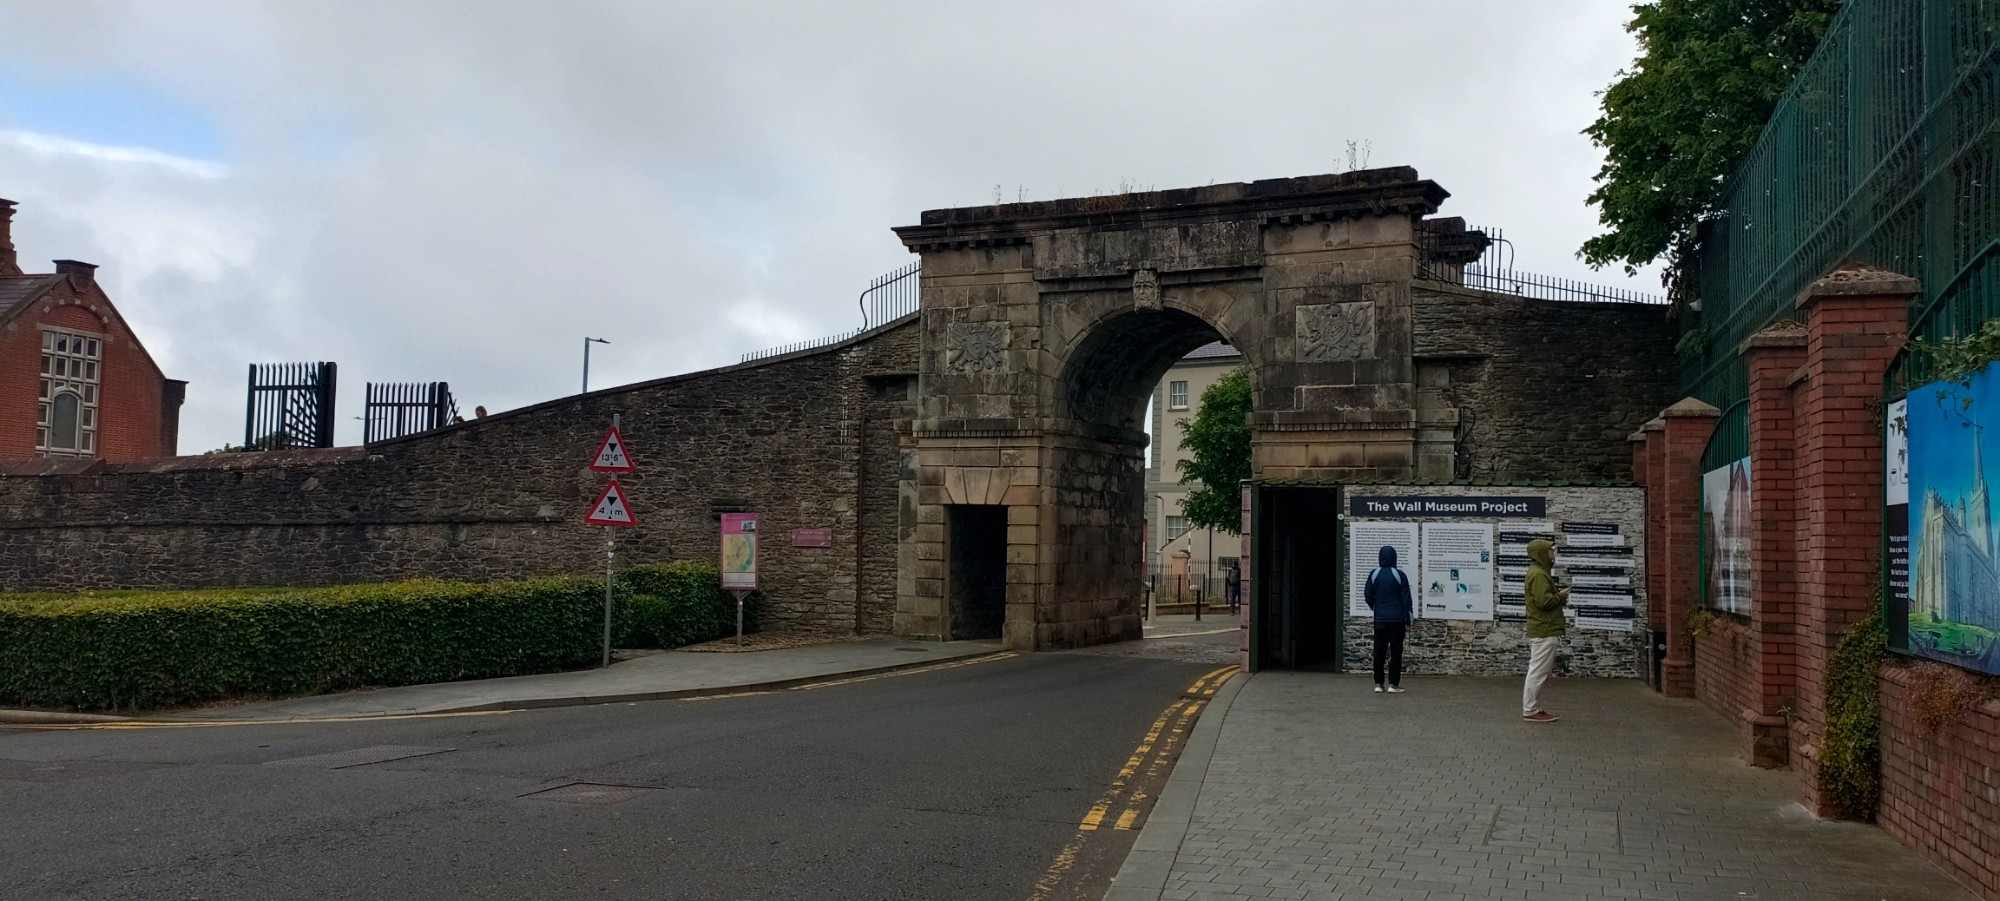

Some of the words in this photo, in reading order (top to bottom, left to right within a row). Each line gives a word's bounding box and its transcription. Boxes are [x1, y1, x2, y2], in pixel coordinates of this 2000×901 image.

[1367, 501, 1390, 512] The
[1393, 501, 1422, 512] Wall
[1425, 502, 1477, 513] Museum
[1481, 502, 1528, 514] Project
